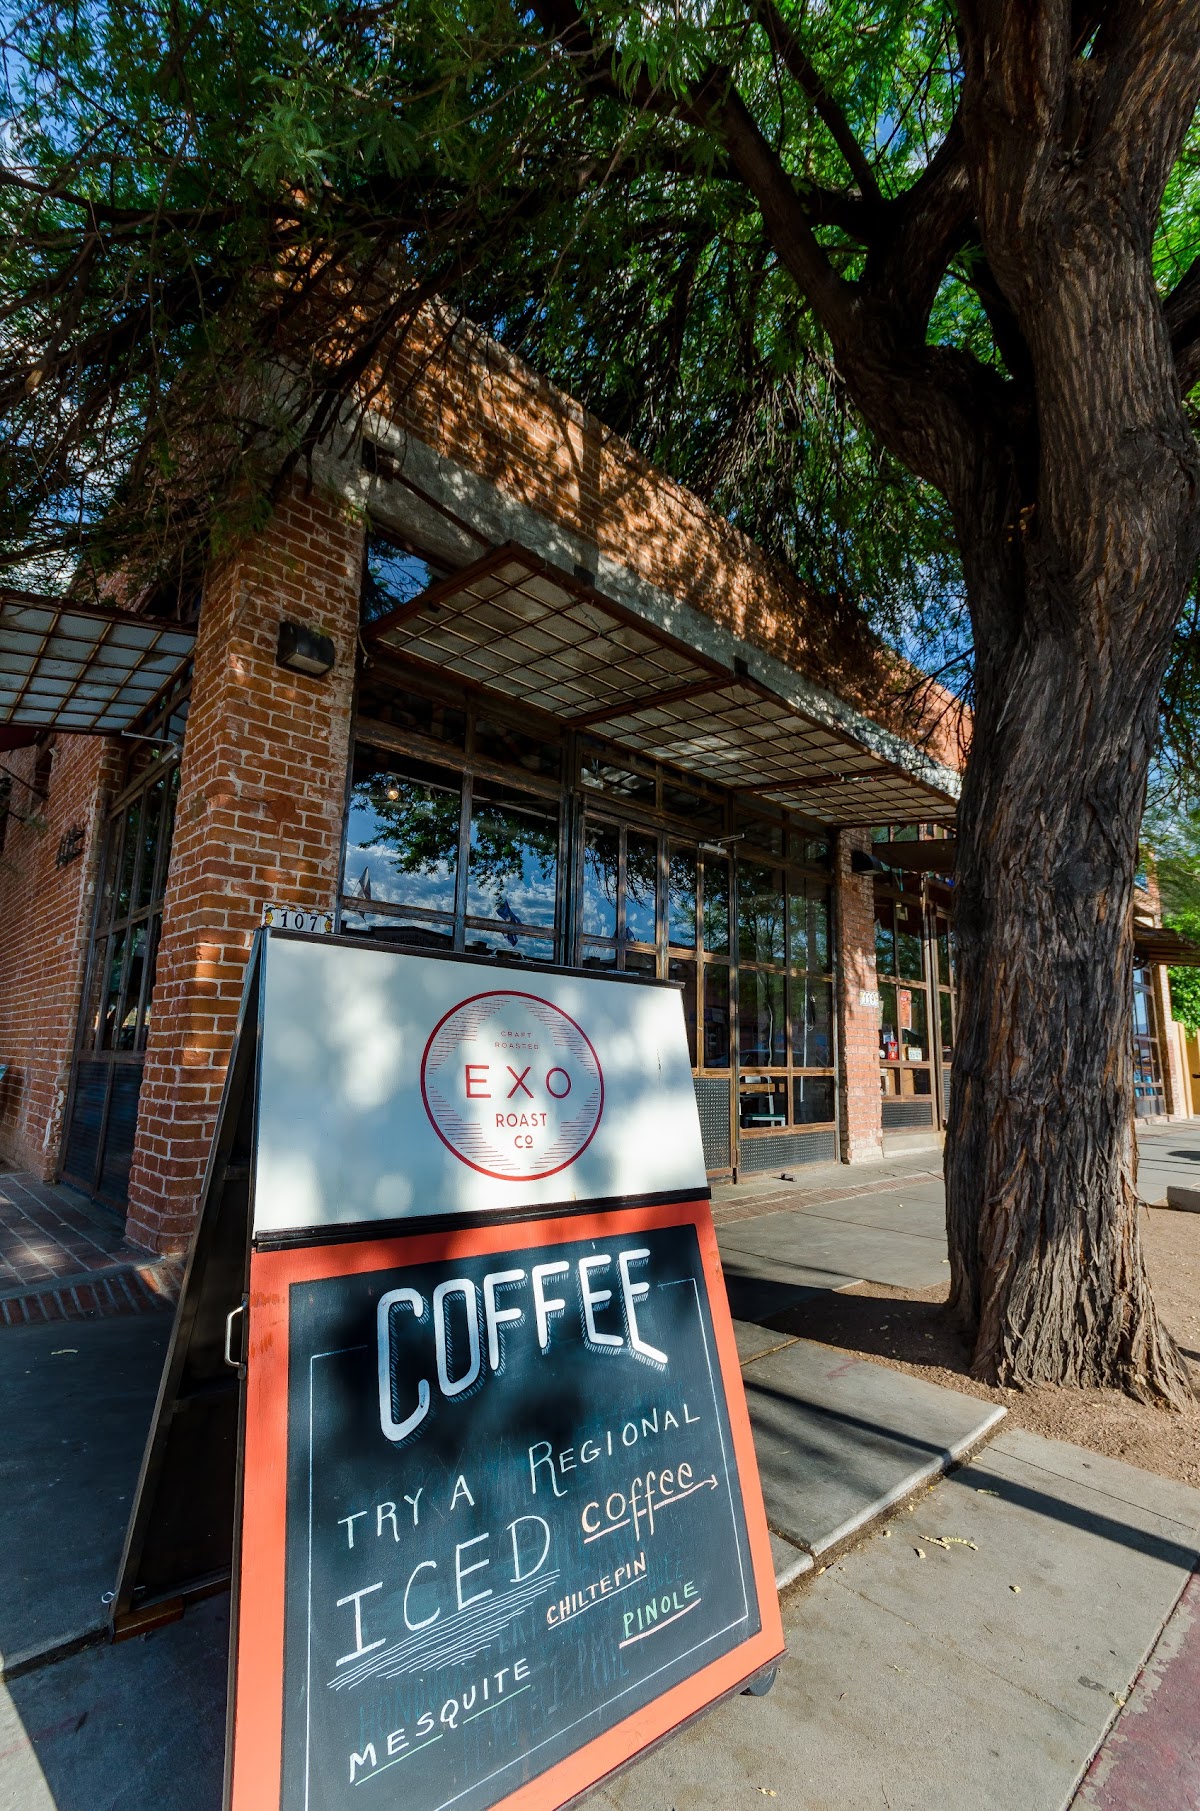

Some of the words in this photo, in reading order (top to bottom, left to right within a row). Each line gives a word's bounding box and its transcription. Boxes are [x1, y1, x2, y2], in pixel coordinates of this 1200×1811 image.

[280, 911, 318, 932] 107
[494, 1041, 539, 1050] ROASTED
[500, 1031, 532, 1039] CRAFT
[465, 1064, 572, 1099] EXO
[495, 1112, 547, 1128] ROAST
[376, 1247, 669, 1443] COFFEE
[337, 1487, 424, 1550] TRY
[450, 1474, 475, 1511] A
[528, 1403, 701, 1497] REGIONAL
[335, 1514, 551, 1668] ICED
[546, 1551, 648, 1625] CHILTEPIN
[621, 1580, 700, 1640] PINOLE
[348, 1657, 532, 1786] MESQUITE
